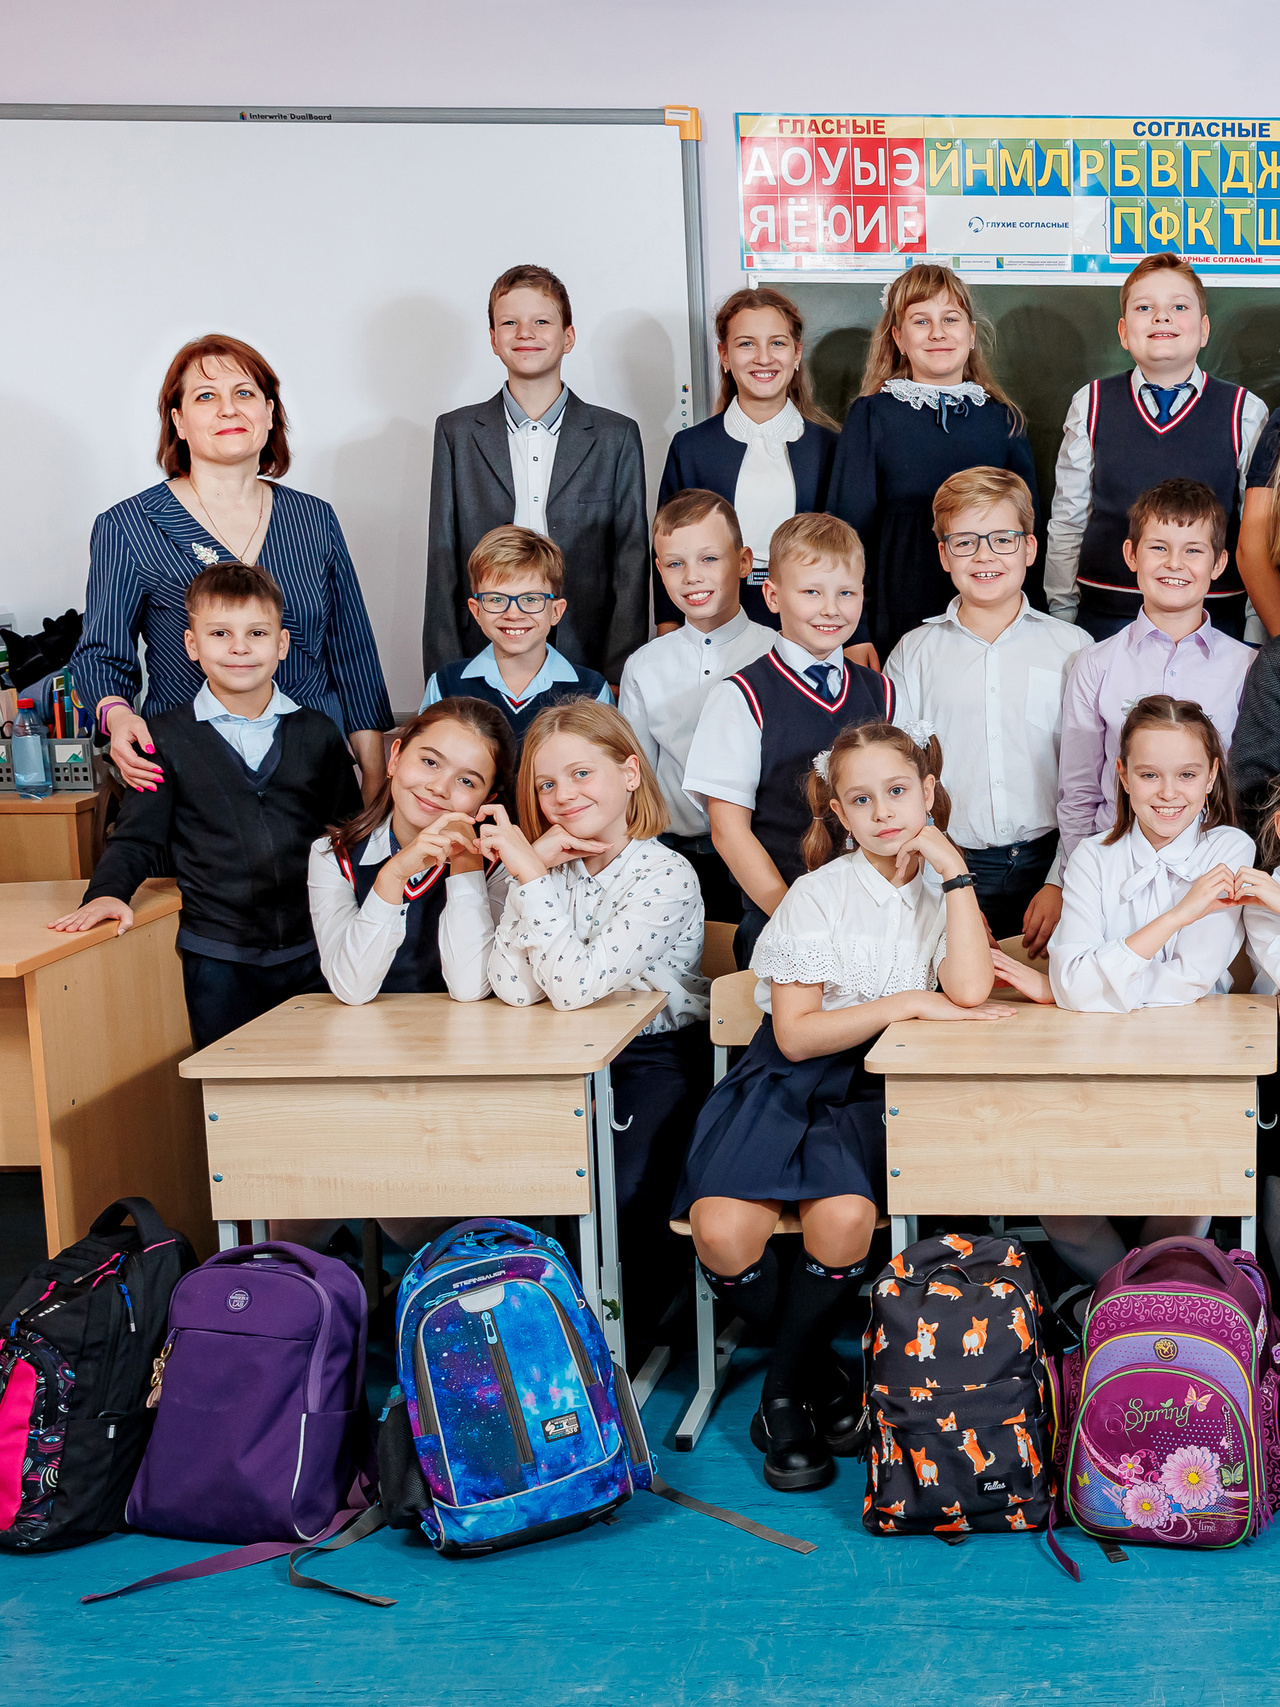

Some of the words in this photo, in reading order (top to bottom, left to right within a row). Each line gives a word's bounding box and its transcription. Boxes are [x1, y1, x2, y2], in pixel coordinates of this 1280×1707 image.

[778, 118, 886, 136] ГЛАСНЫЕ
[1132, 121, 1271, 138] СОГЛАСНЫЕ
[1126, 1398, 1191, 1433] Spring
